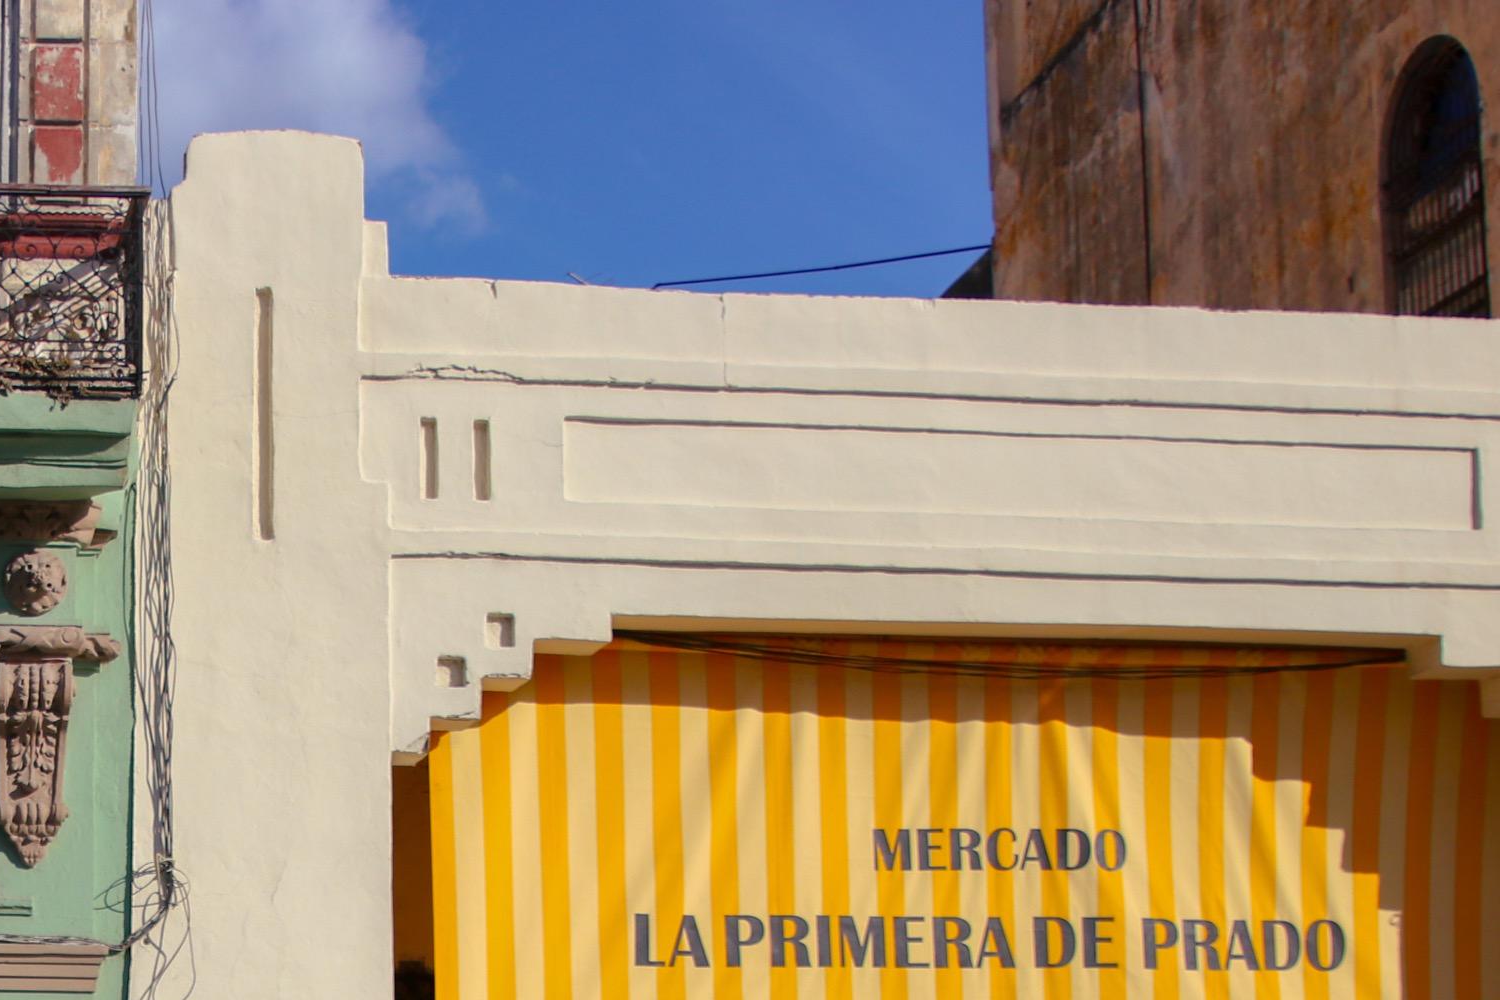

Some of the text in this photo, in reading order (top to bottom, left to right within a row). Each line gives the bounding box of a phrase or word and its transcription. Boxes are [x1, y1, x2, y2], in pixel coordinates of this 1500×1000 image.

[873, 827, 1127, 872] MERCADO
[633, 913, 1347, 972] LA PRIMERA DE PRADO
